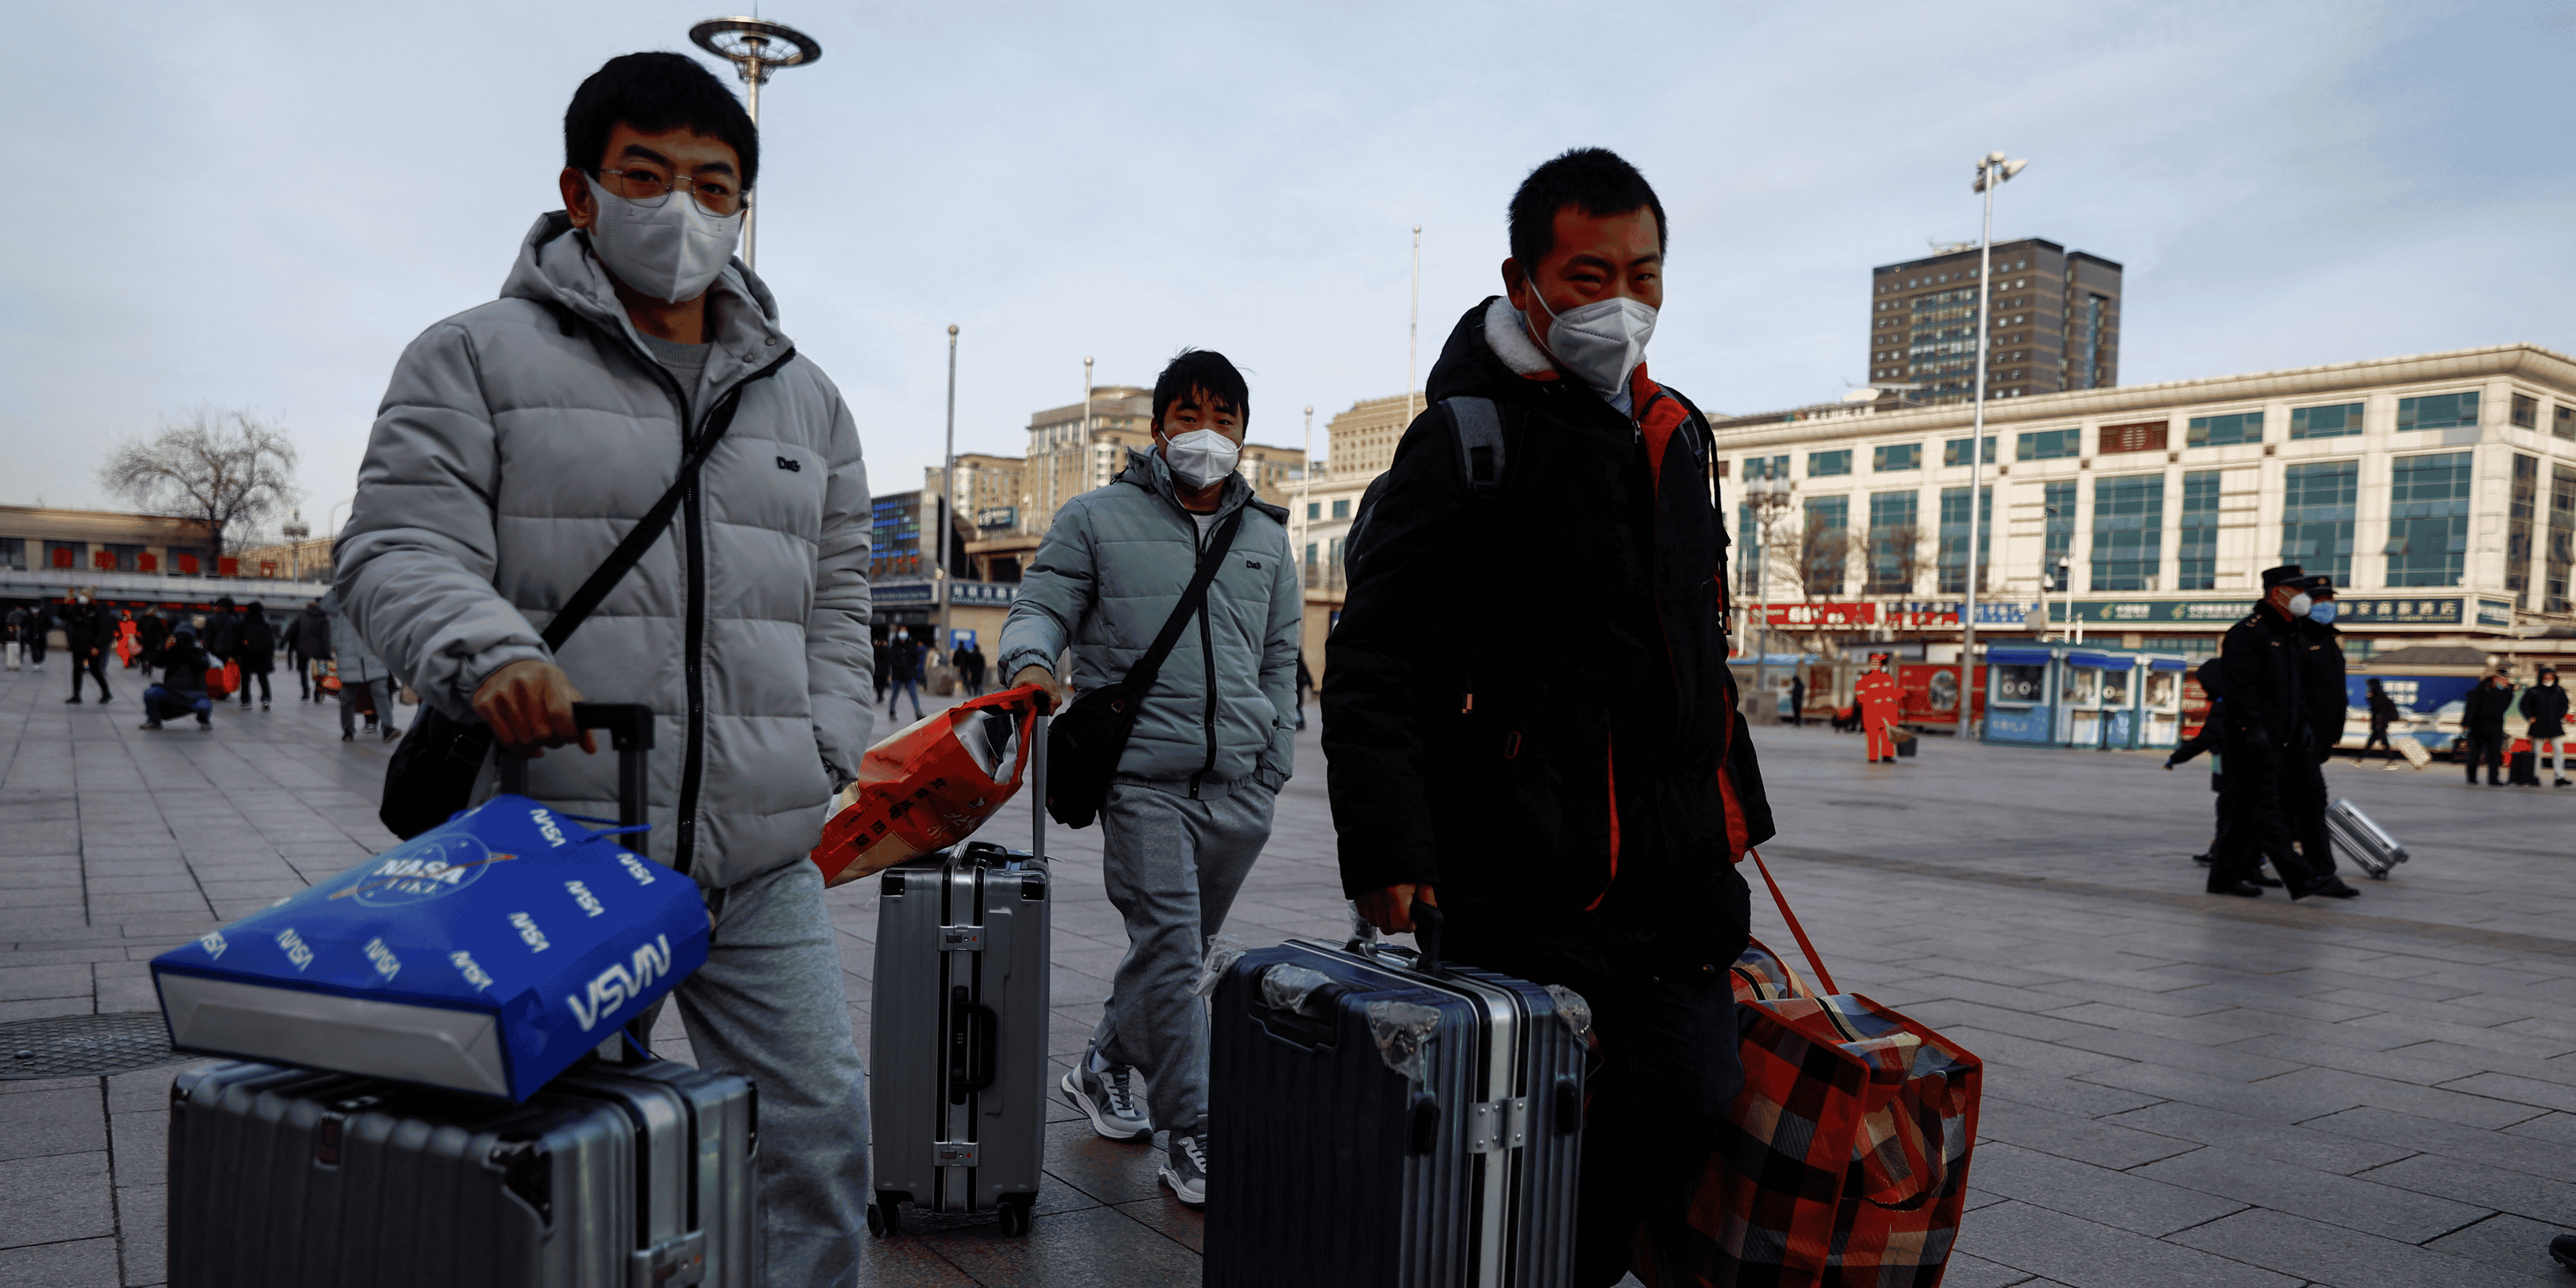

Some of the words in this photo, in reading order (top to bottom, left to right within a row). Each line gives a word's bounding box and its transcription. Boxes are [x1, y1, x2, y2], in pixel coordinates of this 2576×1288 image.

[531, 809, 567, 848] NASA
[373, 859, 467, 884] NASA
[617, 853, 655, 886] NASA
[566, 880, 604, 917] NASA
[276, 928, 315, 972] NASA
[508, 911, 551, 953] NASA
[362, 938, 402, 981] NASA
[449, 951, 494, 991] NASA
